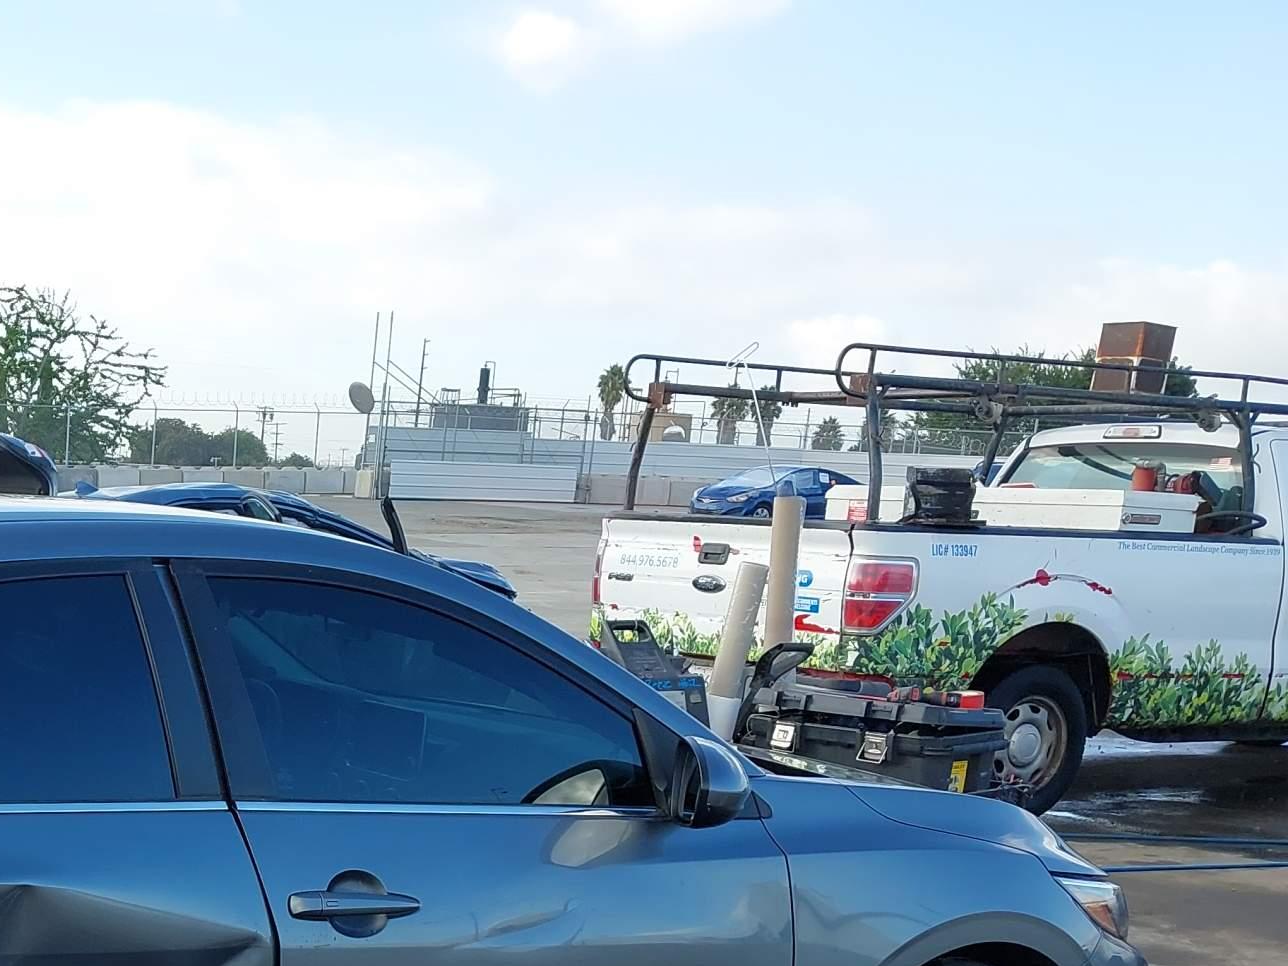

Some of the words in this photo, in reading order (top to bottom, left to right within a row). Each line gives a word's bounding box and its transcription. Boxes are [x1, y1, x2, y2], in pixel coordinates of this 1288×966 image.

[931, 543, 949, 557] LIC#
[951, 543, 978, 557] 133947
[1119, 541, 1131, 551] The
[1132, 542, 1146, 551] Best
[1146, 543, 1186, 552] Commercial
[1187, 544, 1219, 554] Landscape
[1220, 545, 1248, 556] Company
[620, 553, 679, 568] 844.976.5678
